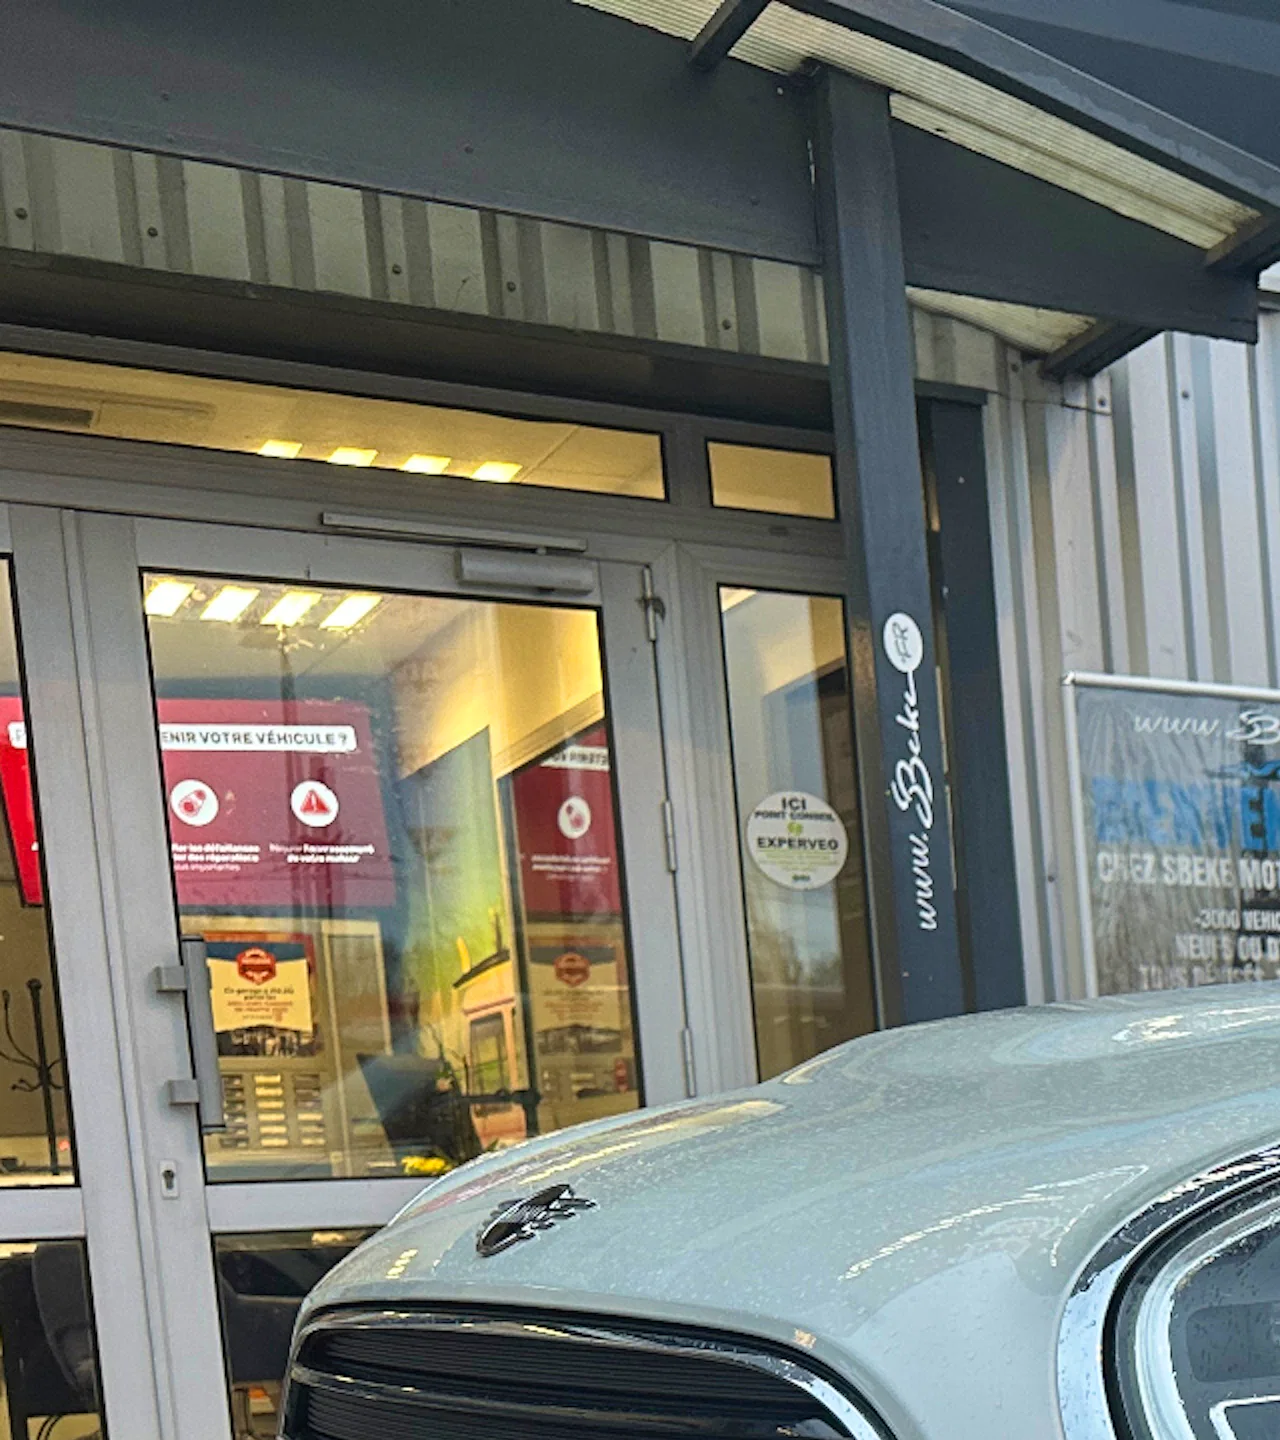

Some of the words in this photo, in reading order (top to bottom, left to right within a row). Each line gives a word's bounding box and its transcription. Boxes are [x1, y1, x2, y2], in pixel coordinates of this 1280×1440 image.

[199, 730, 252, 745] VOTRE
[254, 728, 336, 746] VÉHICULE
[781, 797, 807, 811] ICI
[757, 836, 840, 851] EXPERVEO
[1097, 851, 1157, 885] CHEZ
[1162, 853, 1237, 889] SBEKE
[1238, 934, 1262, 962] OU
